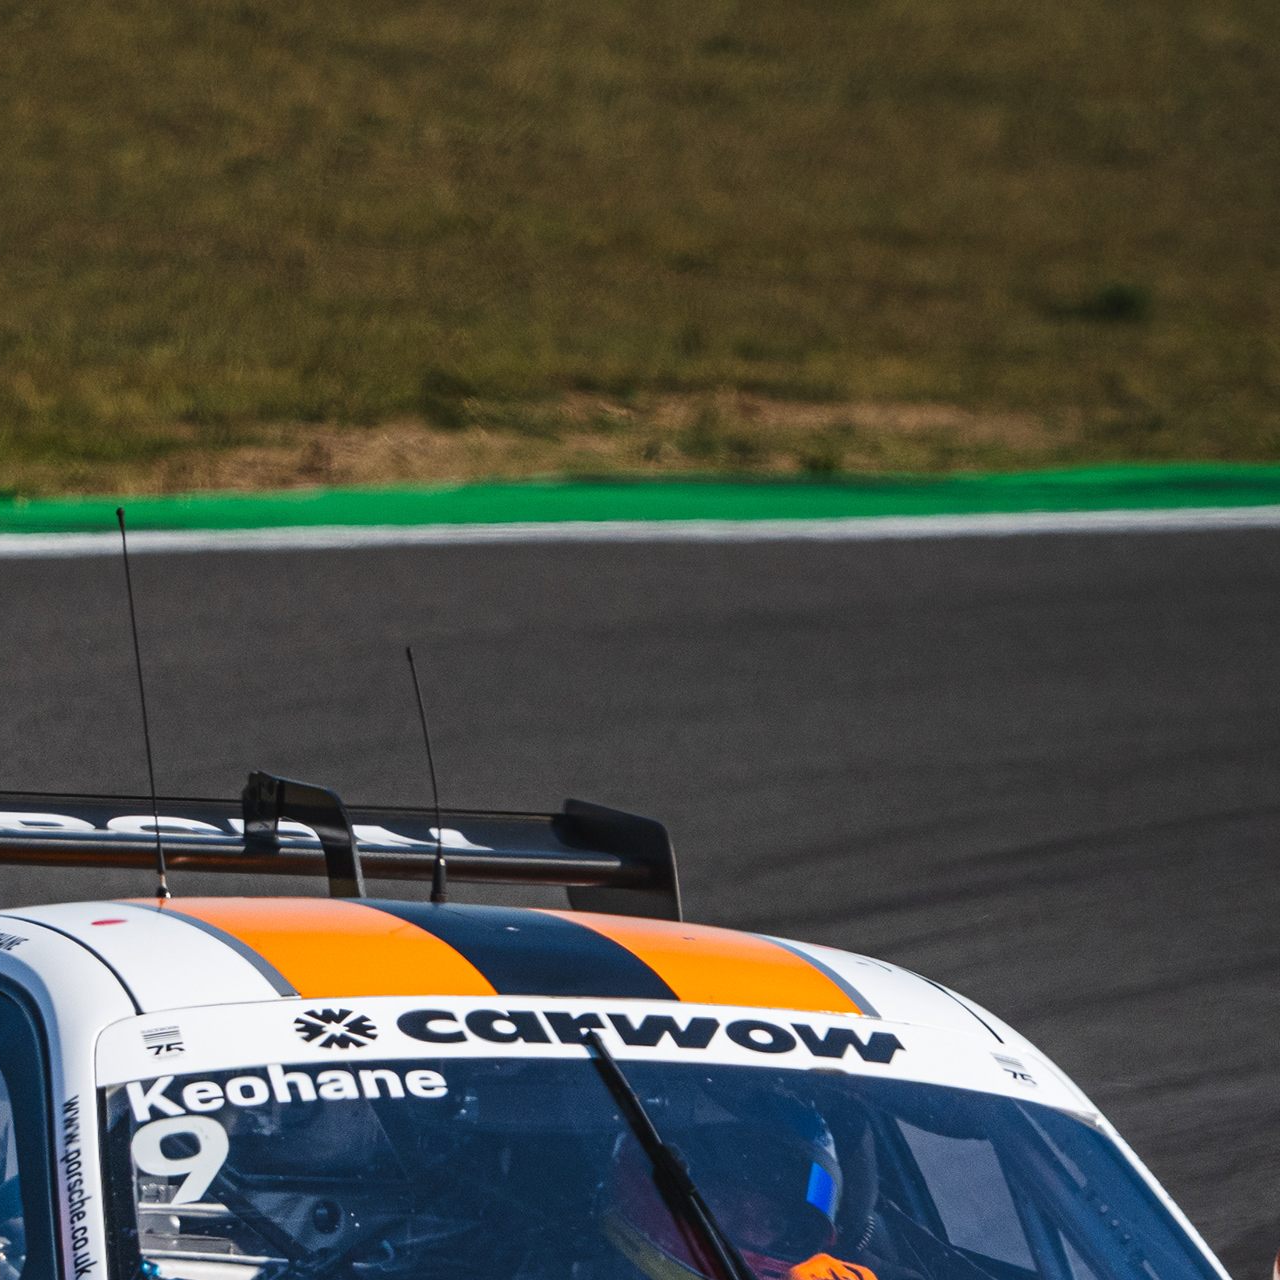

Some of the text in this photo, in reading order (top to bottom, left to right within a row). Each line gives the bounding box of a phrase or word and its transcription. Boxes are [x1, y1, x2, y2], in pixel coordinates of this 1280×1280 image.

[396, 1008, 907, 1064] carwow
[126, 1063, 449, 1123] Keohane
[61, 1094, 99, 1280] www.porsche.co.uk
[130, 1114, 230, 1207] 9
